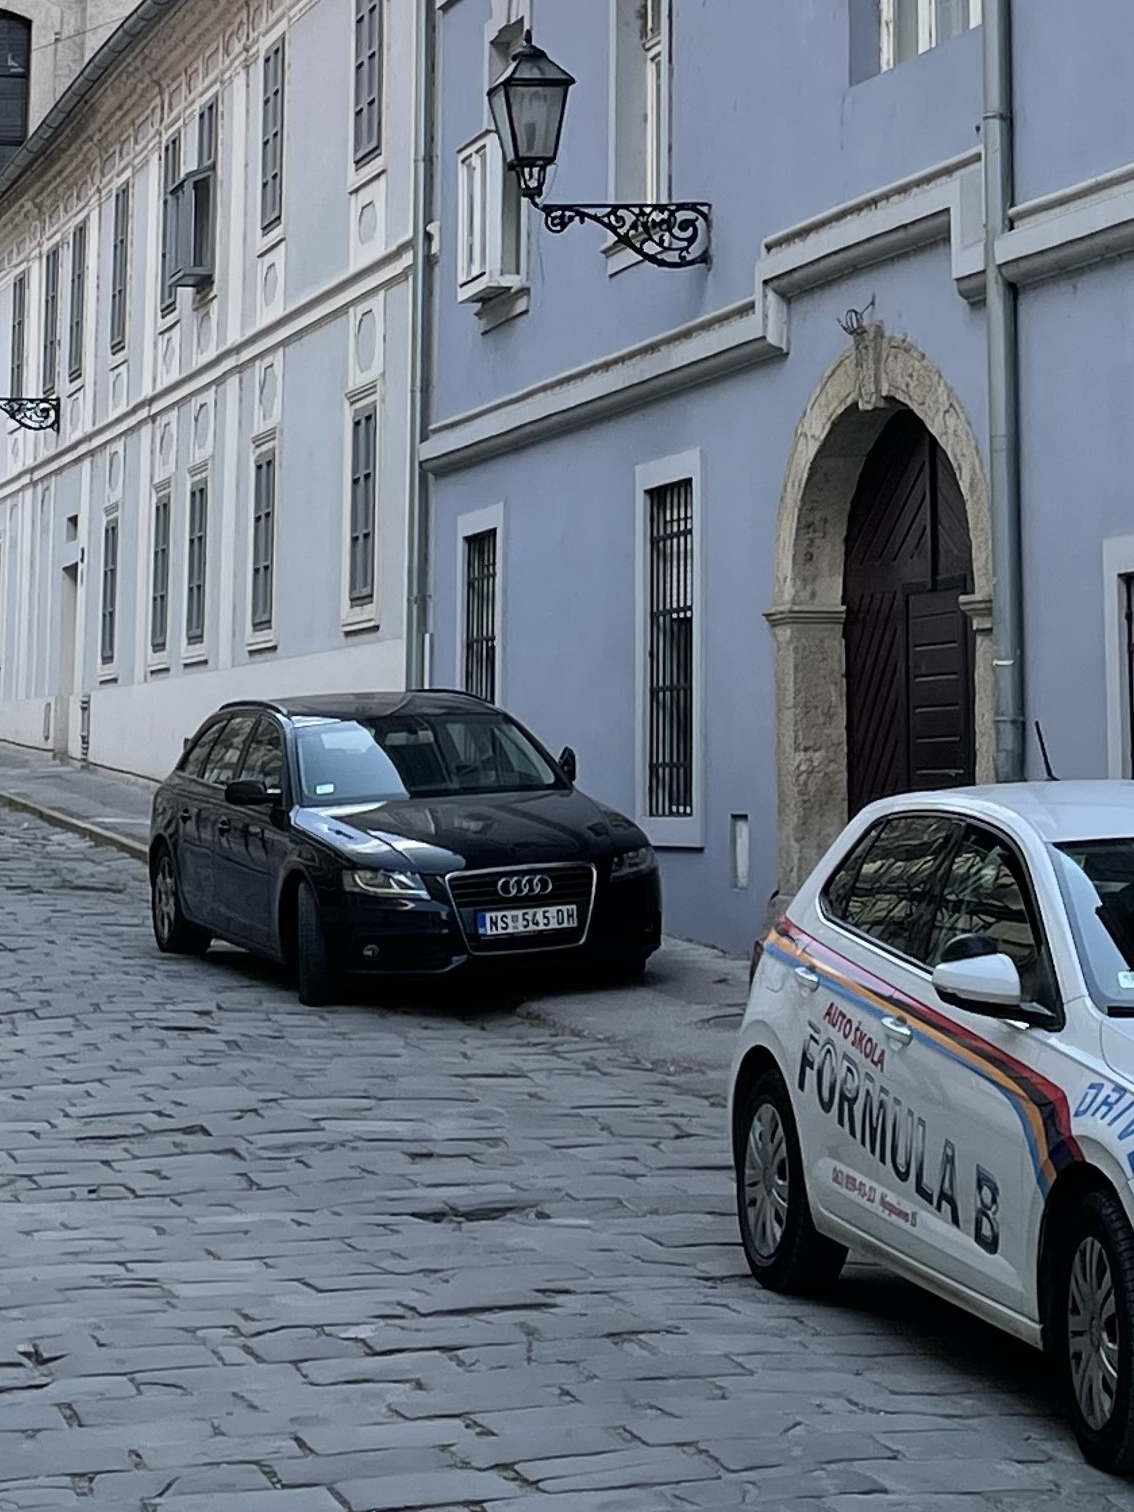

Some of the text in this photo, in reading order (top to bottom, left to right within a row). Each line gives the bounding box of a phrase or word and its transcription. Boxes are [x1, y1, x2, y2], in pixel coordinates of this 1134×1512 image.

[489, 914, 509, 932] NS
[823, 1001, 885, 1073] AUTO ŠKOLA
[797, 1019, 961, 1229] FORMULA
[974, 1163, 1000, 1255] B
